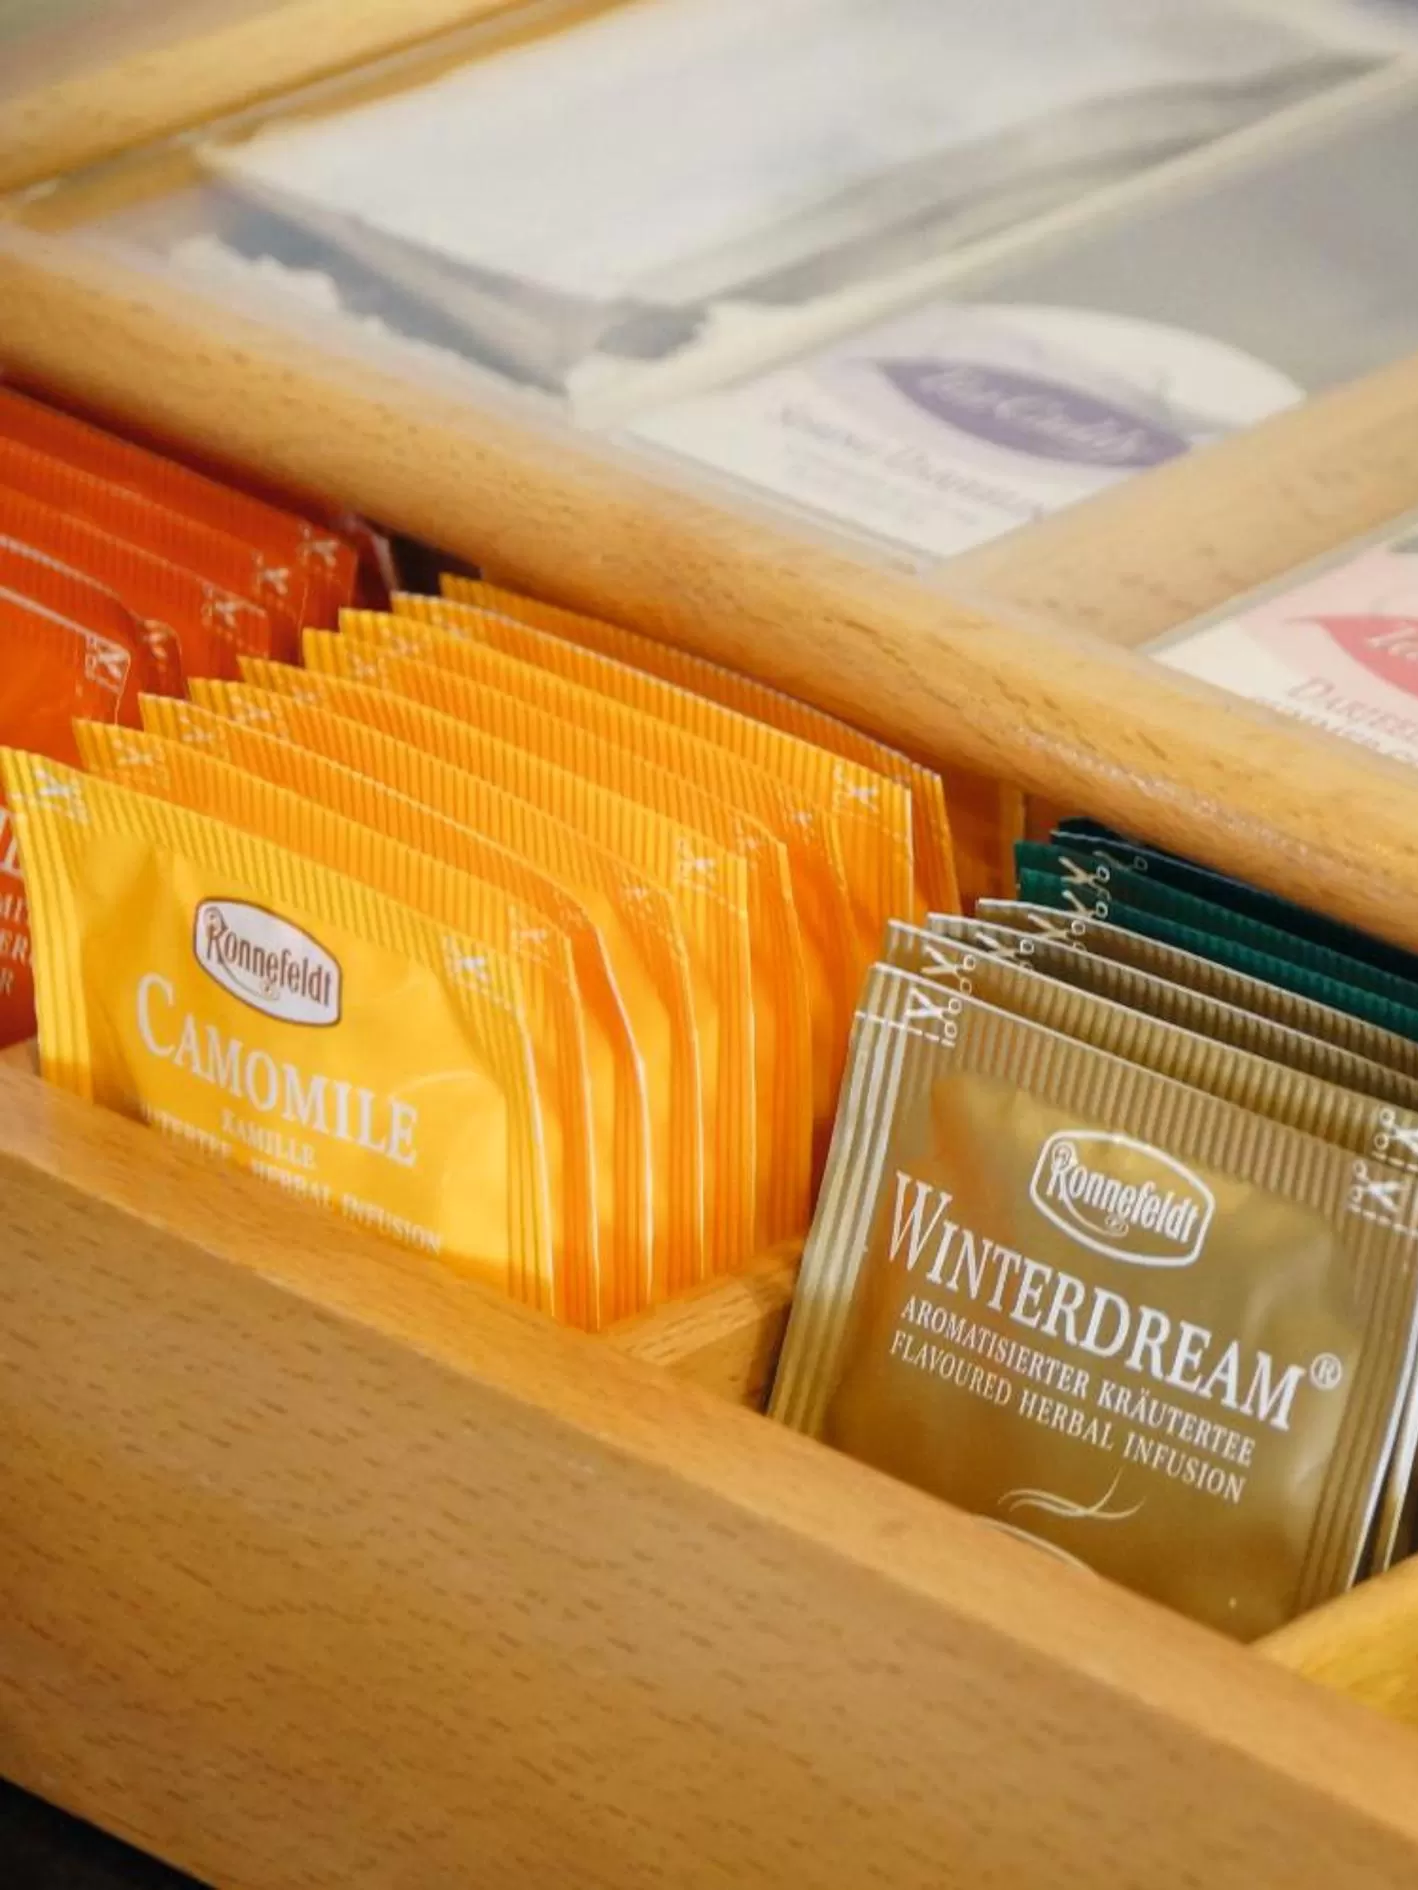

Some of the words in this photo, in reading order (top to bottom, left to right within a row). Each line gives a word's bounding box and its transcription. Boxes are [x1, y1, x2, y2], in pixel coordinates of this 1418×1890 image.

[204, 905, 333, 1008] Ronnefeldt
[135, 972, 419, 1169] CAMOMILE
[1045, 1142, 1200, 1244] Ronnefeldt
[888, 1329, 1014, 1407] FLAVOURED
[1018, 1388, 1115, 1450] HERBAL
[1121, 1432, 1247, 1504] INFUSION
[900, 1295, 1090, 1397] AROMATISIERTER
[1097, 1379, 1257, 1468] KRÄUTERTEE
